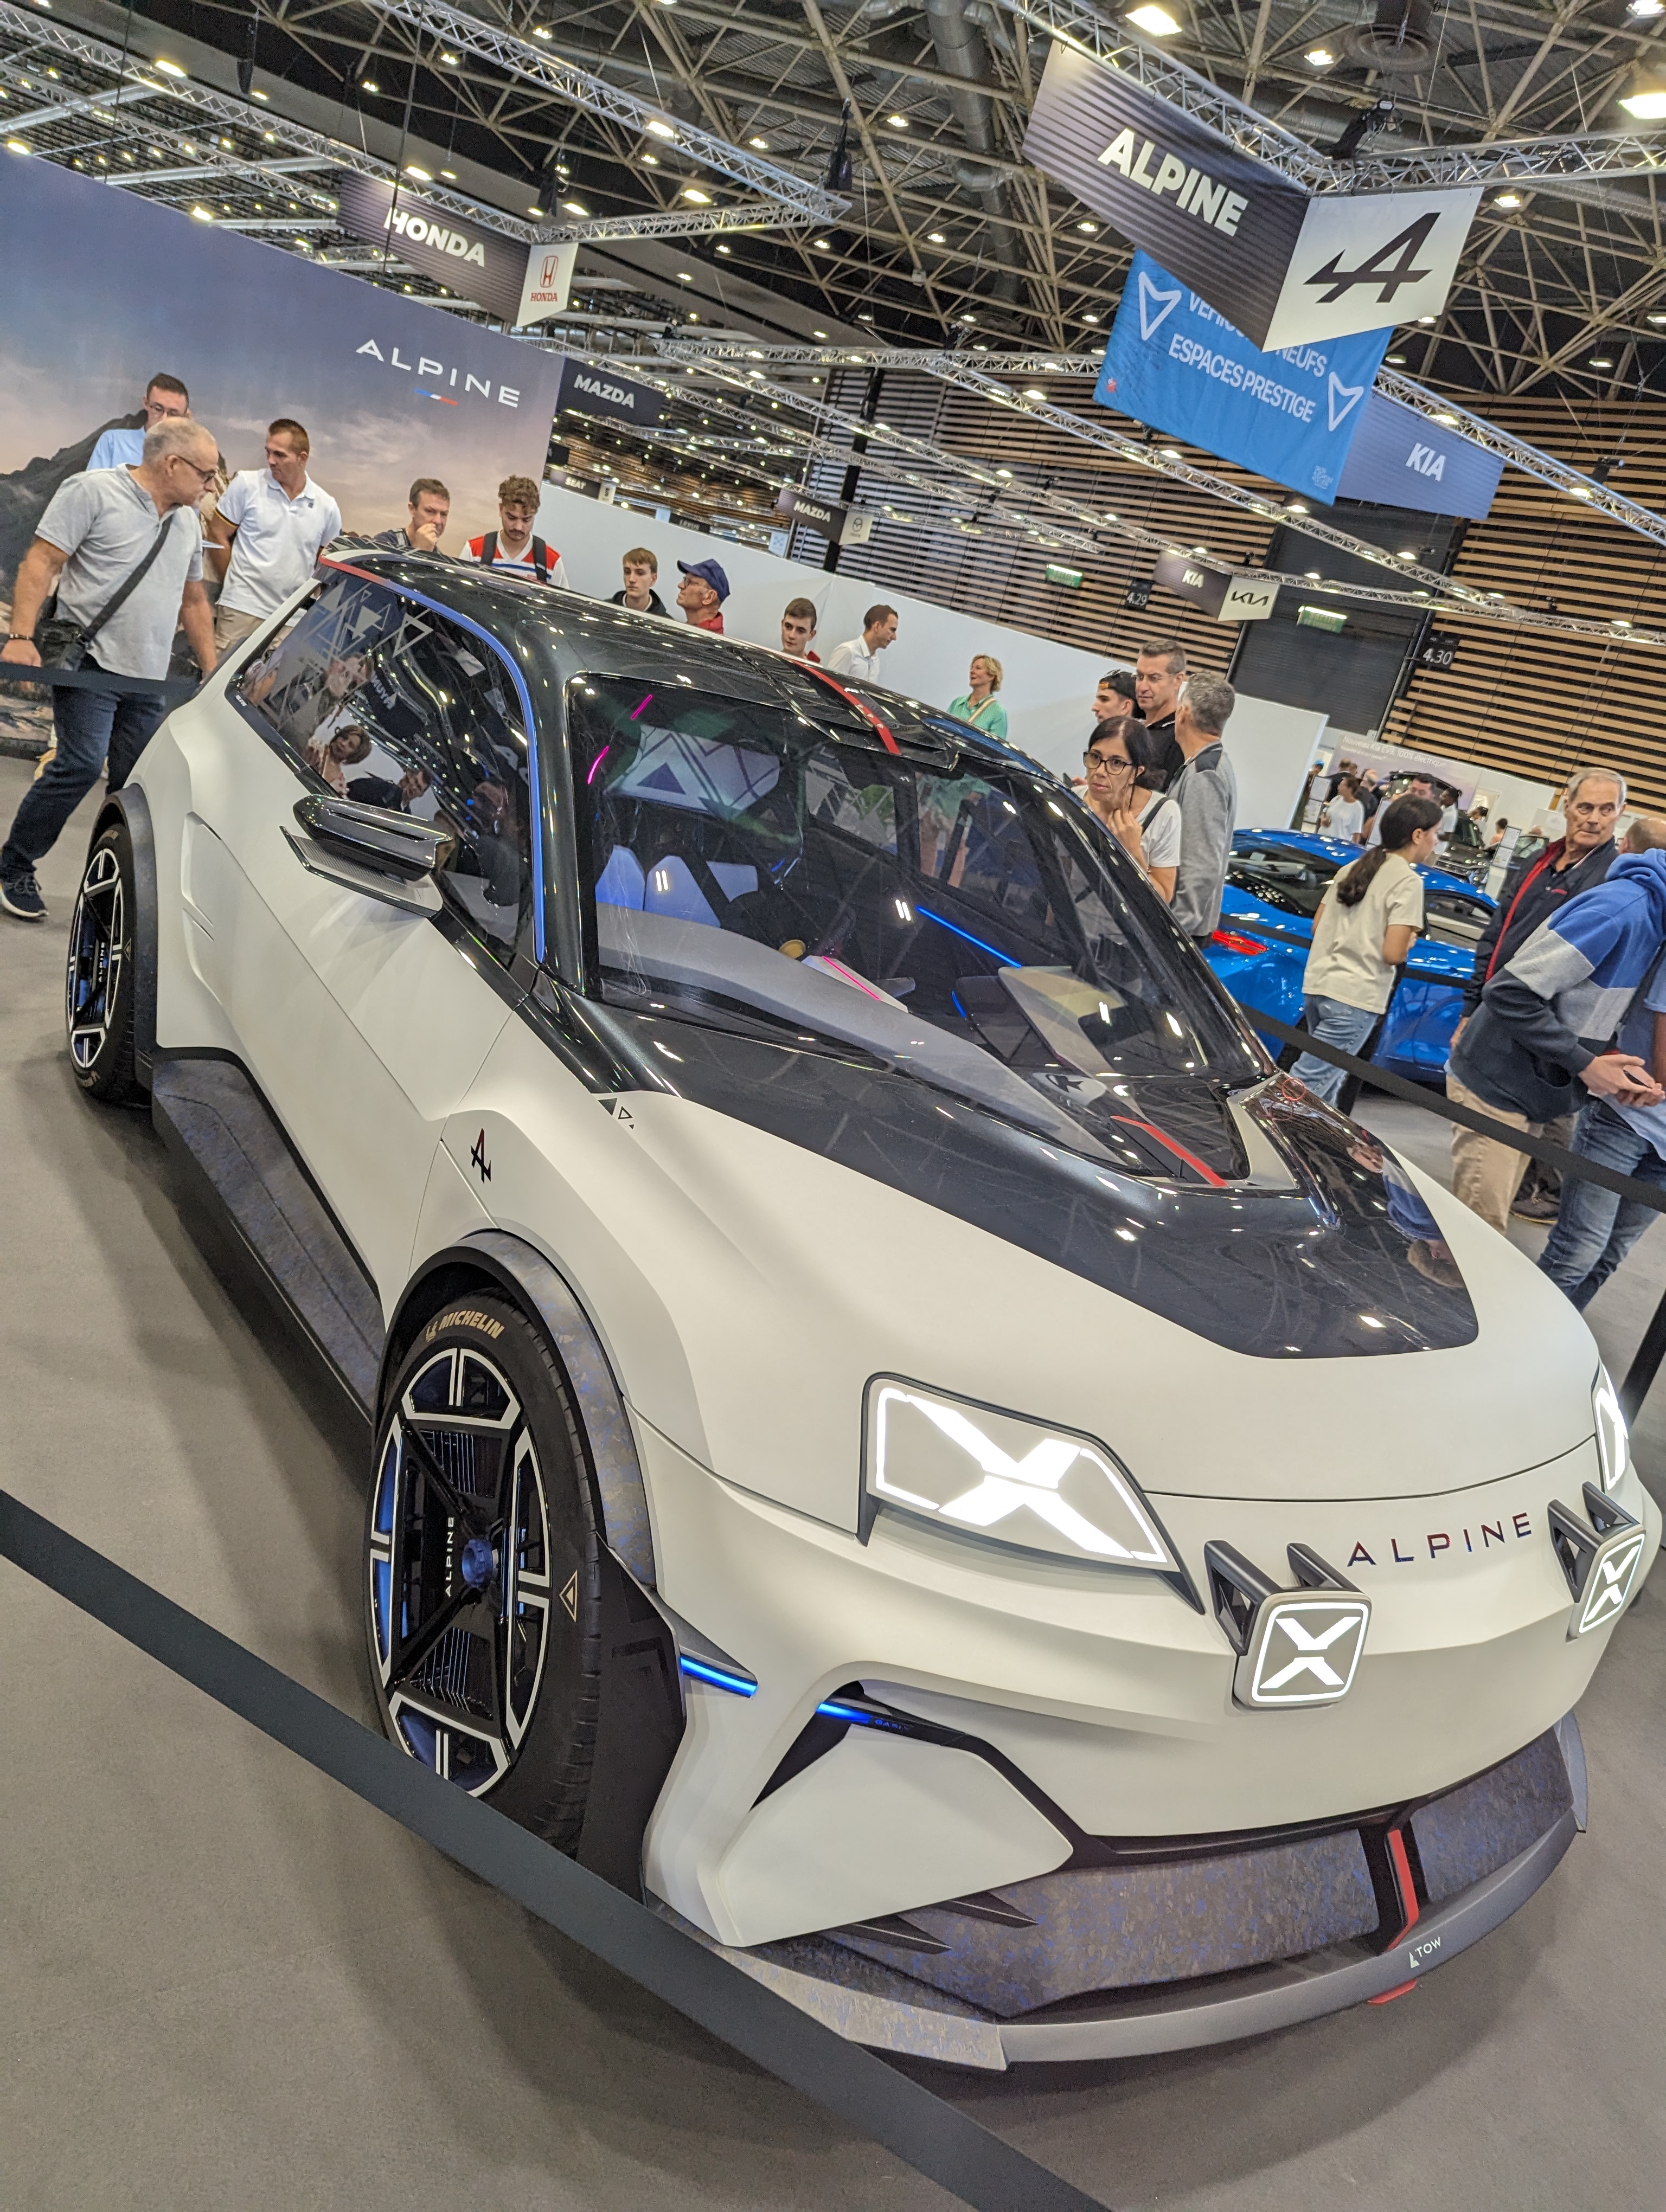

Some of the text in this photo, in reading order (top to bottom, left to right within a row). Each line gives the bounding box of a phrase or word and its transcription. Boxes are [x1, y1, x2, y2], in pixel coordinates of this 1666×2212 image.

[1098, 128, 1250, 237] ALPINE
[383, 207, 485, 268] HONDA
[530, 293, 558, 302] HONDA
[356, 339, 520, 408] ALPINE
[1168, 332, 1316, 424] ESPACES PRESTIGE
[574, 374, 635, 409] MAZDA
[1406, 442, 1445, 481] KIA
[565, 477, 586, 490] SEAT
[793, 500, 832, 523] MAZDA
[1182, 570, 1204, 588] KIA
[1127, 591, 1148, 606] 4.29
[1423, 648, 1453, 665] 4.30
[1343, 736, 1369, 749] Nouveau
[1370, 741, 1380, 751] Kia
[1397, 750, 1413, 760] 100%
[1414, 753, 1446, 767] électrique
[439, 1309, 504, 1339] MICHELIN
[1347, 1512, 1533, 1567] ALPINE
[445, 1515, 454, 1598] ALPINE
[1415, 1937, 1442, 1956] TOW
